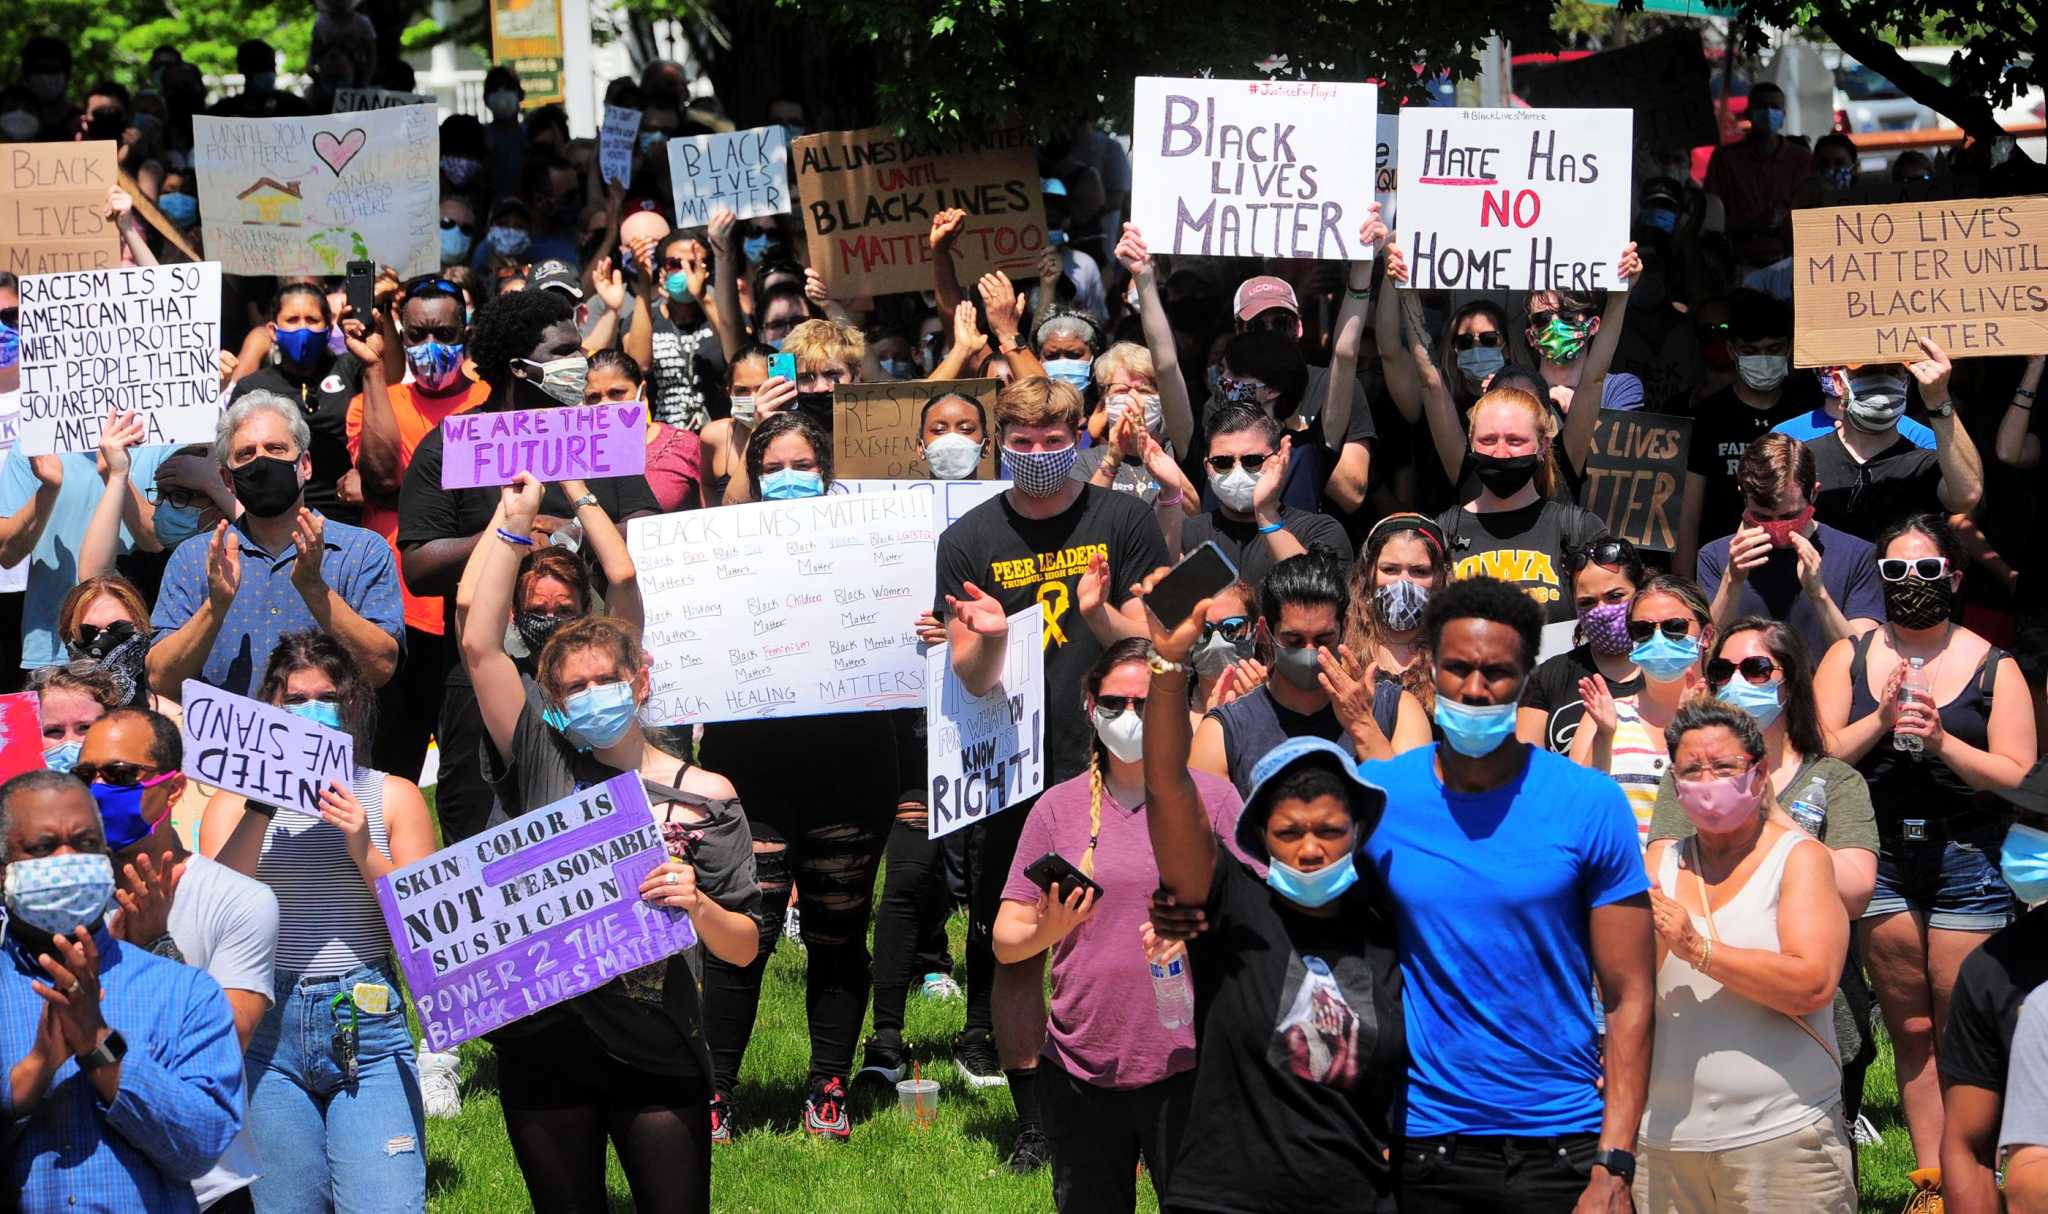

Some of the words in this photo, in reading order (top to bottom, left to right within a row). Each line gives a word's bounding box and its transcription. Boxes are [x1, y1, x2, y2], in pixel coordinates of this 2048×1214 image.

[13, 149, 104, 189] BLACK
[682, 130, 770, 177] BLACK
[801, 146, 841, 174] ALL
[842, 142, 897, 170] LIVES
[1423, 129, 1500, 179] HATE
[1528, 129, 1598, 184] HAS
[693, 165, 772, 198] LIVES
[877, 162, 949, 192] UNTIL
[1211, 161, 1317, 199] LIVES
[17, 204, 103, 236] LIVES
[809, 194, 928, 236] BLACK
[1173, 196, 1348, 258] MATTER
[1480, 189, 1541, 229] NO
[1836, 212, 1894, 245] NO
[1919, 206, 2021, 242] LIVES
[9, 248, 113, 274] MATTER
[968, 224, 1042, 261] TOO
[1411, 232, 1511, 290] HOME
[1528, 237, 1608, 291] HERE
[1809, 249, 1952, 284] MATTER
[1964, 244, 2048, 275] UNTIL
[21, 272, 110, 304] RACISM
[120, 269, 155, 296] IS
[171, 267, 200, 292] SO
[1849, 289, 1950, 319] BLACK
[1961, 286, 2048, 312] LIVES
[21, 301, 127, 335] AMERICAN
[135, 295, 197, 323] THAT
[20, 334, 66, 362] WHEN
[72, 331, 112, 357] YOU
[118, 322, 216, 353] PROTEST
[1877, 323, 2005, 354] MATTER
[22, 365, 61, 394] IT,
[67, 356, 140, 389] PEOPLE
[144, 348, 219, 378] THINK
[21, 394, 59, 421] YOU
[62, 389, 92, 417] ARE
[92, 378, 218, 413] PROTESTING
[444, 417, 480, 442] WE
[491, 411, 549, 439] ARE
[560, 406, 611, 432] THE
[1607, 420, 1681, 459] LIVES
[474, 434, 611, 484] FUTURE
[844, 436, 917, 459] EXISTEN
[888, 460, 926, 477] OR
[641, 514, 722, 550] BLACK
[737, 507, 800, 537] LIVES
[812, 493, 928, 531] MATTER!!!
[1586, 467, 1676, 549] TTER
[786, 541, 816, 555] Black
[869, 531, 894, 546] Black
[992, 558, 1036, 581] PEER
[1038, 543, 1108, 572] LEADERS
[1044, 569, 1066, 580] HIGH
[1068, 566, 1089, 576] SCHO
[642, 575, 695, 594] Matters
[747, 597, 779, 614] Black
[786, 592, 822, 608] Children
[834, 586, 865, 604] Black
[872, 584, 911, 598] Women
[682, 603, 722, 619] History
[841, 611, 880, 627] Matter
[651, 630, 696, 646] Matters
[728, 647, 758, 666] Black
[762, 640, 810, 657] Feminism
[829, 640, 857, 656] Black
[864, 637, 895, 650] Mental
[902, 632, 919, 646] Hea
[680, 653, 703, 668] Men
[735, 665, 772, 681] Matters
[834, 657, 867, 670] Matters
[648, 695, 711, 722] BLACK
[725, 686, 796, 712] HEALING
[818, 669, 925, 699] MATTERS!
[1008, 693, 1024, 725] YOU
[187, 698, 289, 760] STAND
[303, 733, 349, 781] WE
[961, 737, 997, 774] KNOW
[197, 747, 322, 812] NITED
[394, 856, 461, 900] SKIN
[476, 810, 569, 865] COLOR
[580, 793, 614, 822] IS
[403, 886, 485, 950] NOT
[499, 824, 663, 908] REASONABLE
[433, 878, 619, 974] SUSPICION
[417, 960, 523, 1022] POWER
[528, 940, 559, 976] 2
[564, 913, 627, 960] THE
[429, 998, 515, 1050] BLACK
[523, 964, 591, 1012] LIVES
[597, 924, 697, 977] MATTER
